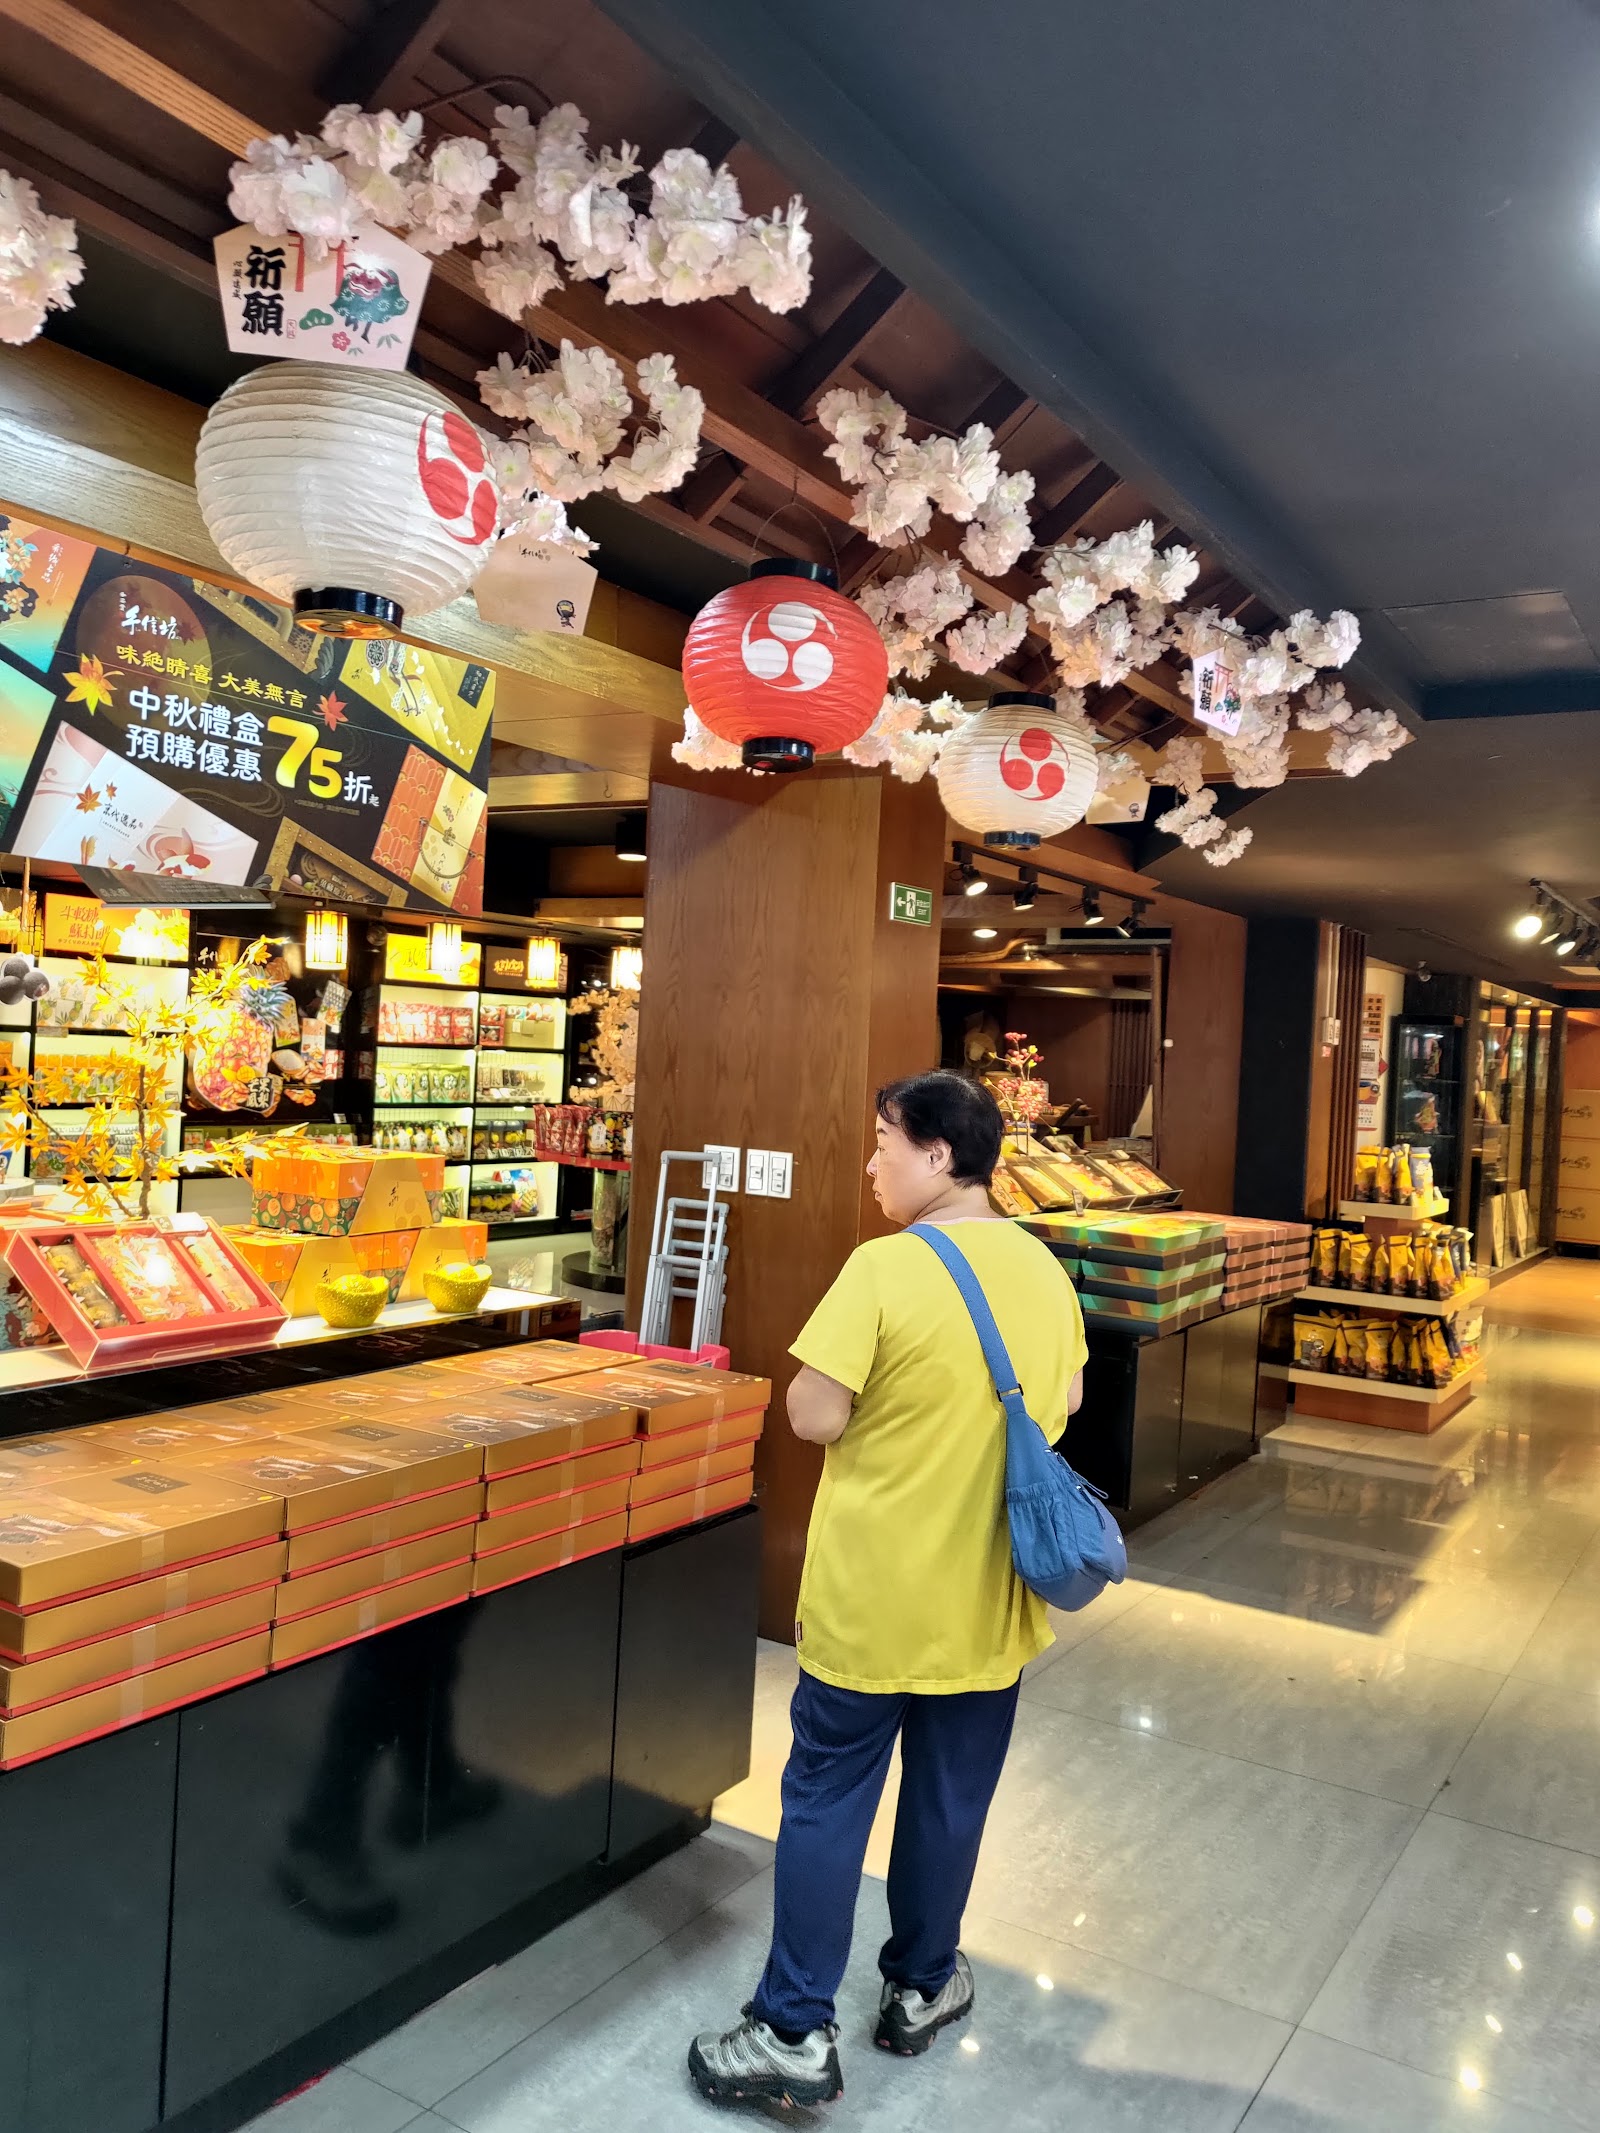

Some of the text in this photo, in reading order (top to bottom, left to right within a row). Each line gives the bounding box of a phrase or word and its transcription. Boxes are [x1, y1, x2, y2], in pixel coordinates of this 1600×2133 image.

[242, 245, 286, 336] 祈願
[121, 604, 178, 640] 手信坊
[128, 685, 264, 747] 中秋禮盒
[217, 672, 308, 709] 大美無言
[1200, 667, 1214, 713] 祈願
[125, 723, 263, 782] 預購優惠
